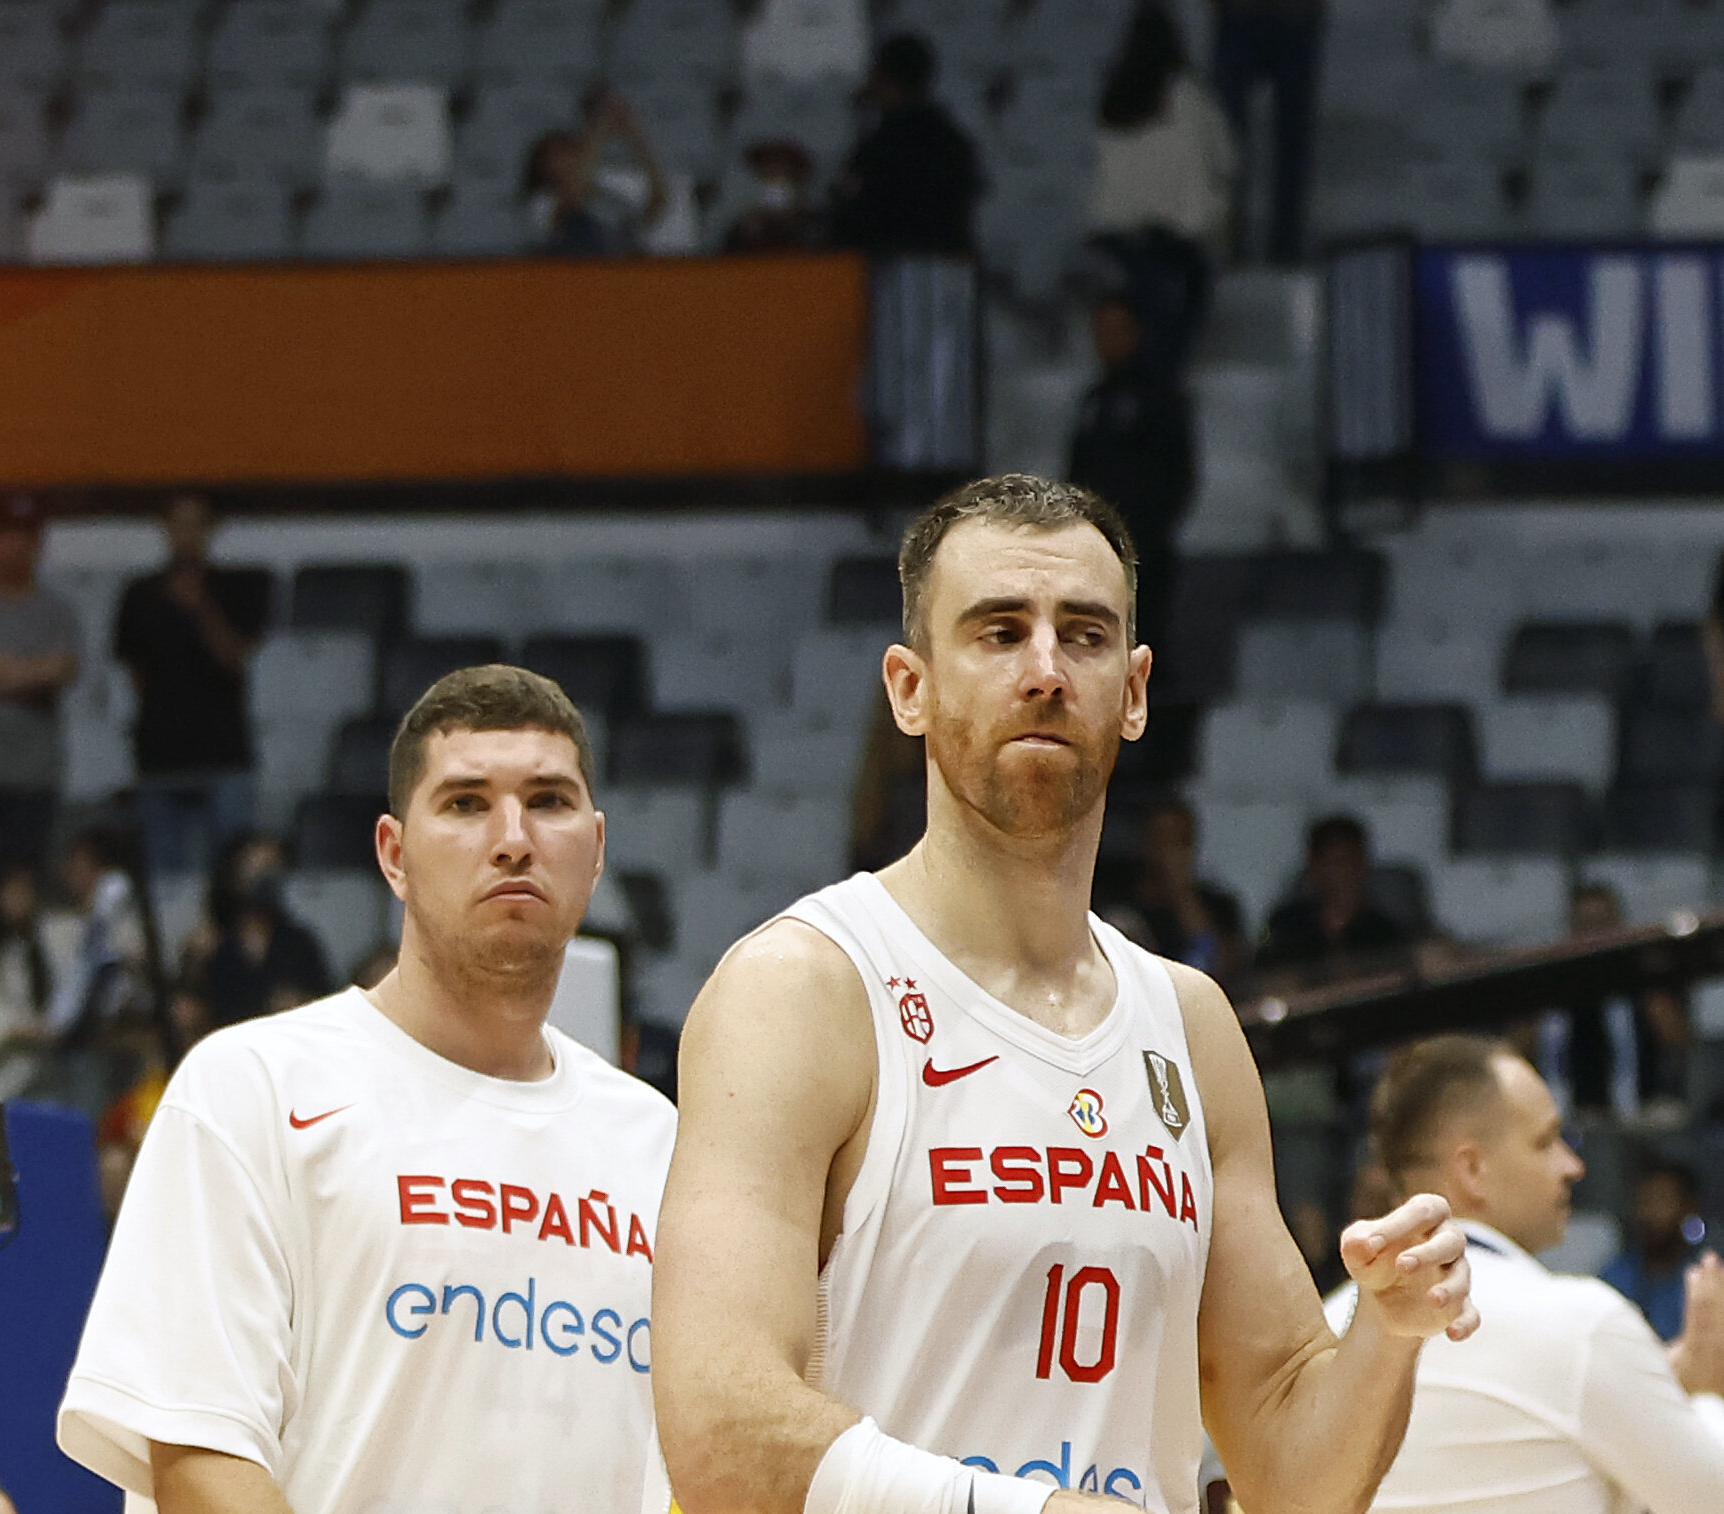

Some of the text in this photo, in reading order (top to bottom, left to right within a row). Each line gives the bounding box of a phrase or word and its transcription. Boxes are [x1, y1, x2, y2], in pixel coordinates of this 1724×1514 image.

[1453, 252, 1724, 444] WI
[397, 1174, 653, 1264] ESPAÑA
[929, 1145, 1200, 1232] ESPAÑA
[1036, 1263, 1121, 1383] 10
